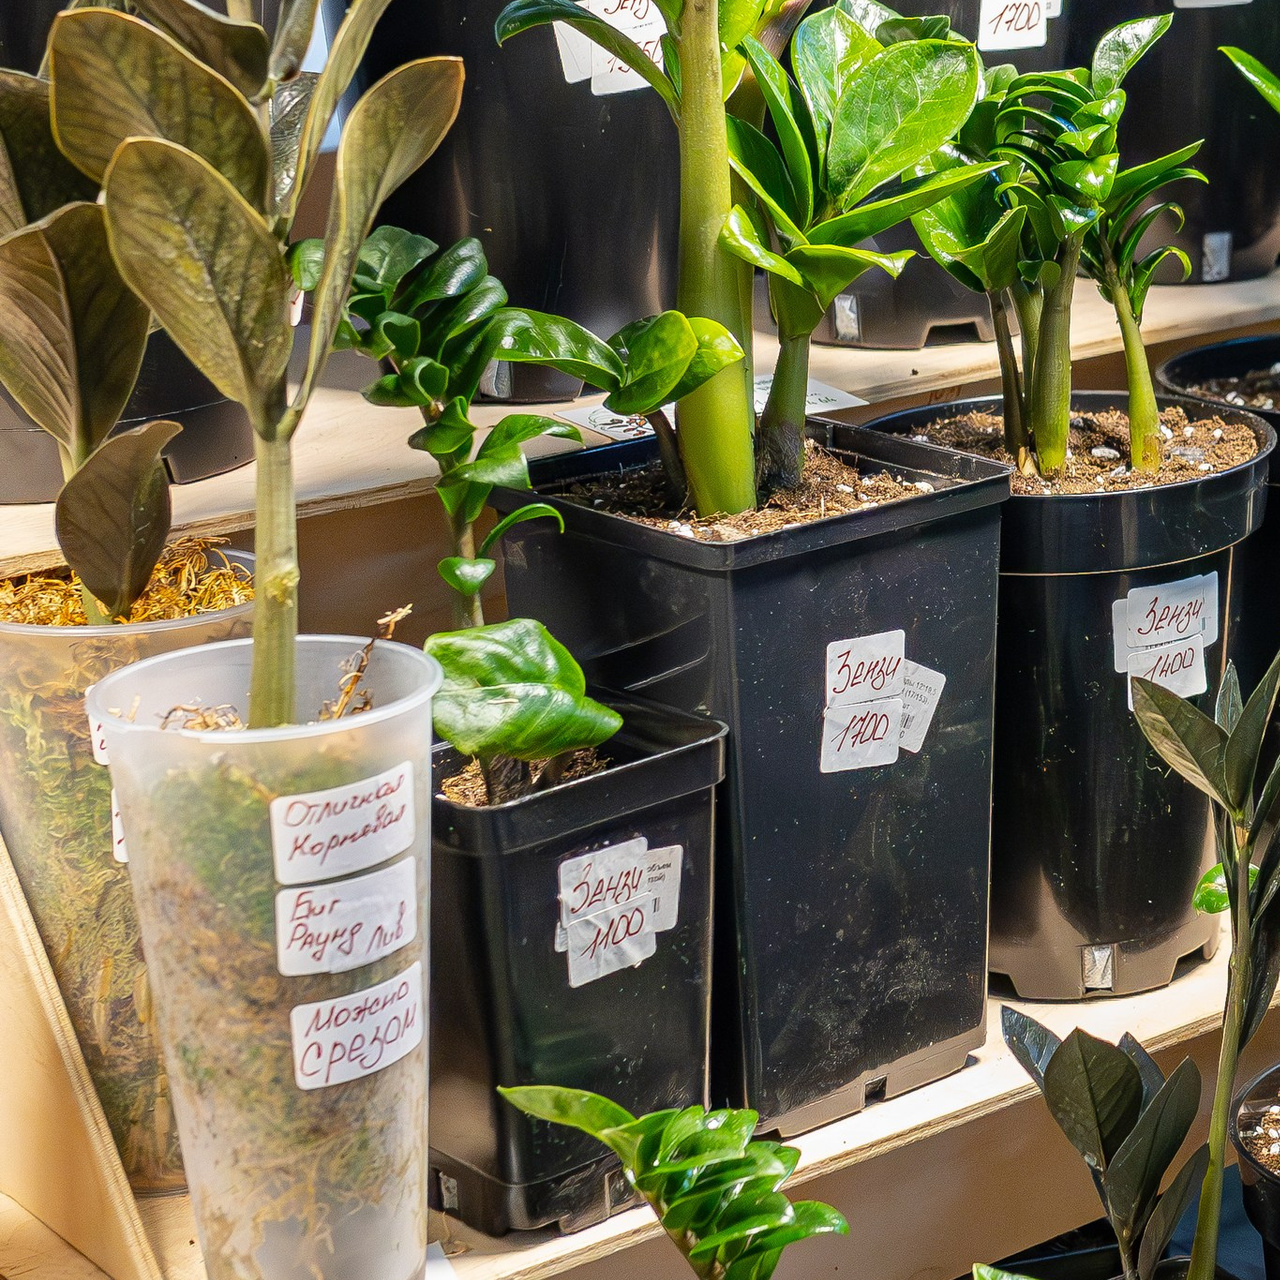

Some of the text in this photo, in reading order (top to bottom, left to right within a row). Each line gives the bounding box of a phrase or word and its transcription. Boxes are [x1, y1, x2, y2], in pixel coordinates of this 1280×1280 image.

[988, 2, 1041, 35] 1700
[1137, 596, 1203, 635] Зензи
[832, 650, 902, 694] Зензи
[1143, 647, 1195, 683] 1400
[830, 710, 889, 753] 1700
[284, 774, 405, 827] Отличная
[287, 803, 407, 866] Корневая
[290, 890, 342, 924] Биг
[570, 862, 644, 915] Зензи
[286, 900, 406, 962] Раунд Лив
[579, 907, 645, 960] 1100
[304, 980, 410, 1038] Можно
